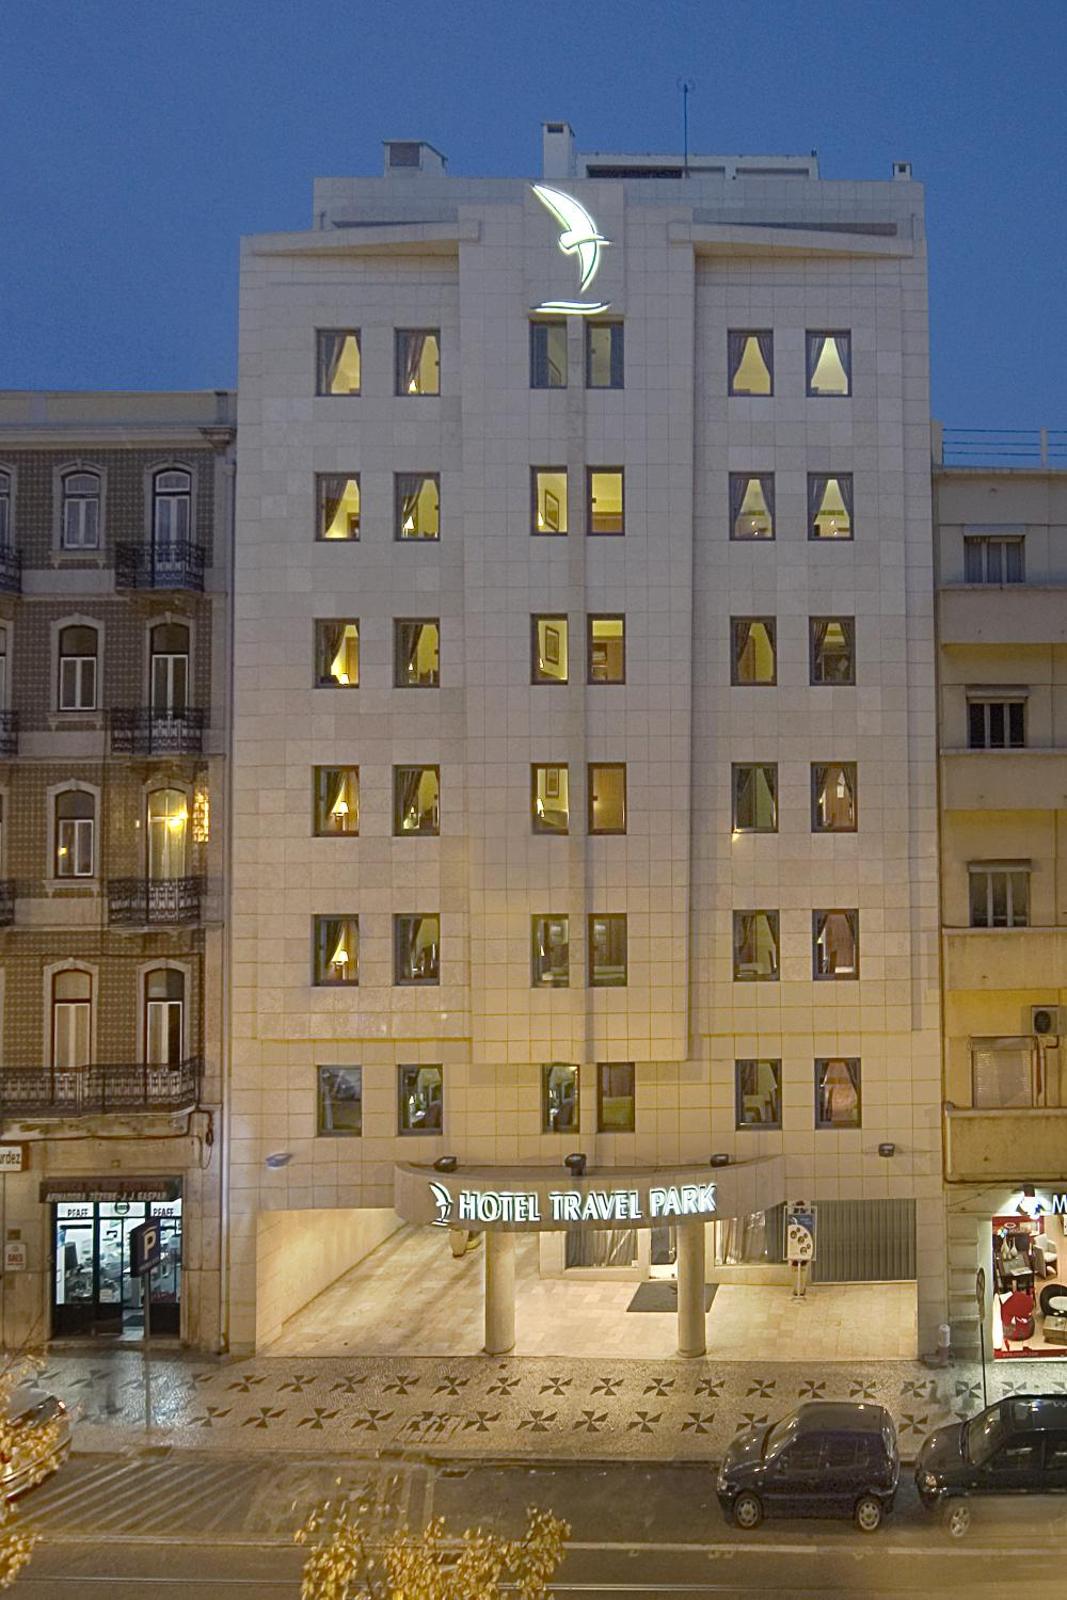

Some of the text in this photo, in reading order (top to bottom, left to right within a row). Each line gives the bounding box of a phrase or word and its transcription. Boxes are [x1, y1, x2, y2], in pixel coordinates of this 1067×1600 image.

[153, 1207, 174, 1217] PFAFF
[458, 1182, 718, 1222] HOTEL TRAVEL PARK
[67, 1208, 88, 1217] PFAFF
[144, 1231, 156, 1261] P
